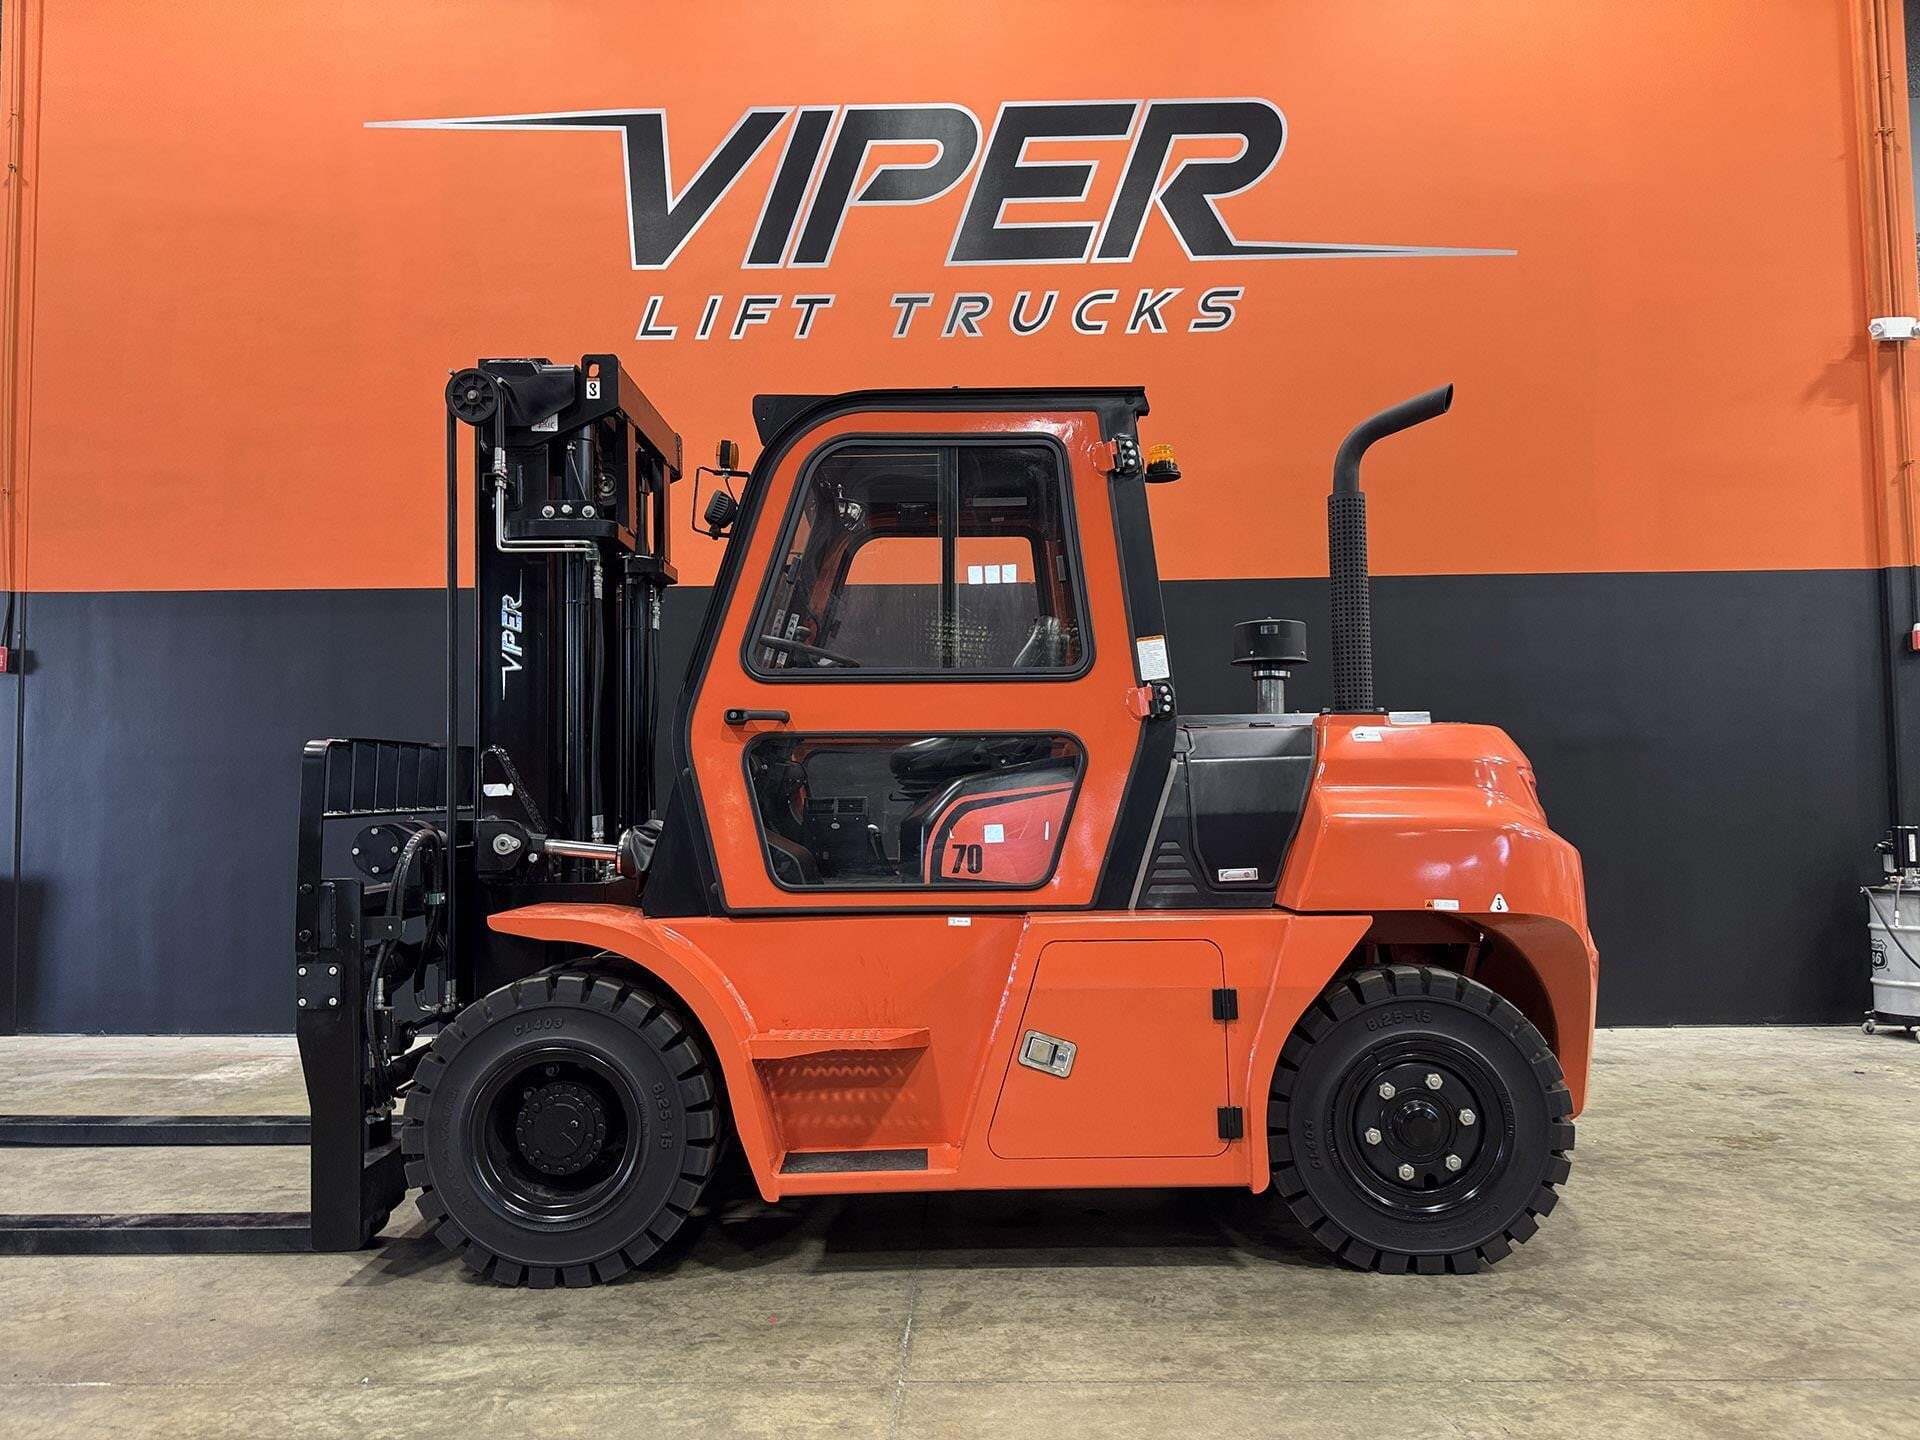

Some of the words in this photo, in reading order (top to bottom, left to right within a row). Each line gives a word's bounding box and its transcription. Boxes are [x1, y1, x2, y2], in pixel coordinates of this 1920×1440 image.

[364, 96, 1518, 271] VIPER
[634, 293, 836, 340] LIFT
[889, 286, 1245, 339] TRUCKS
[501, 568, 522, 701] VIPER
[951, 844, 983, 874] 70
